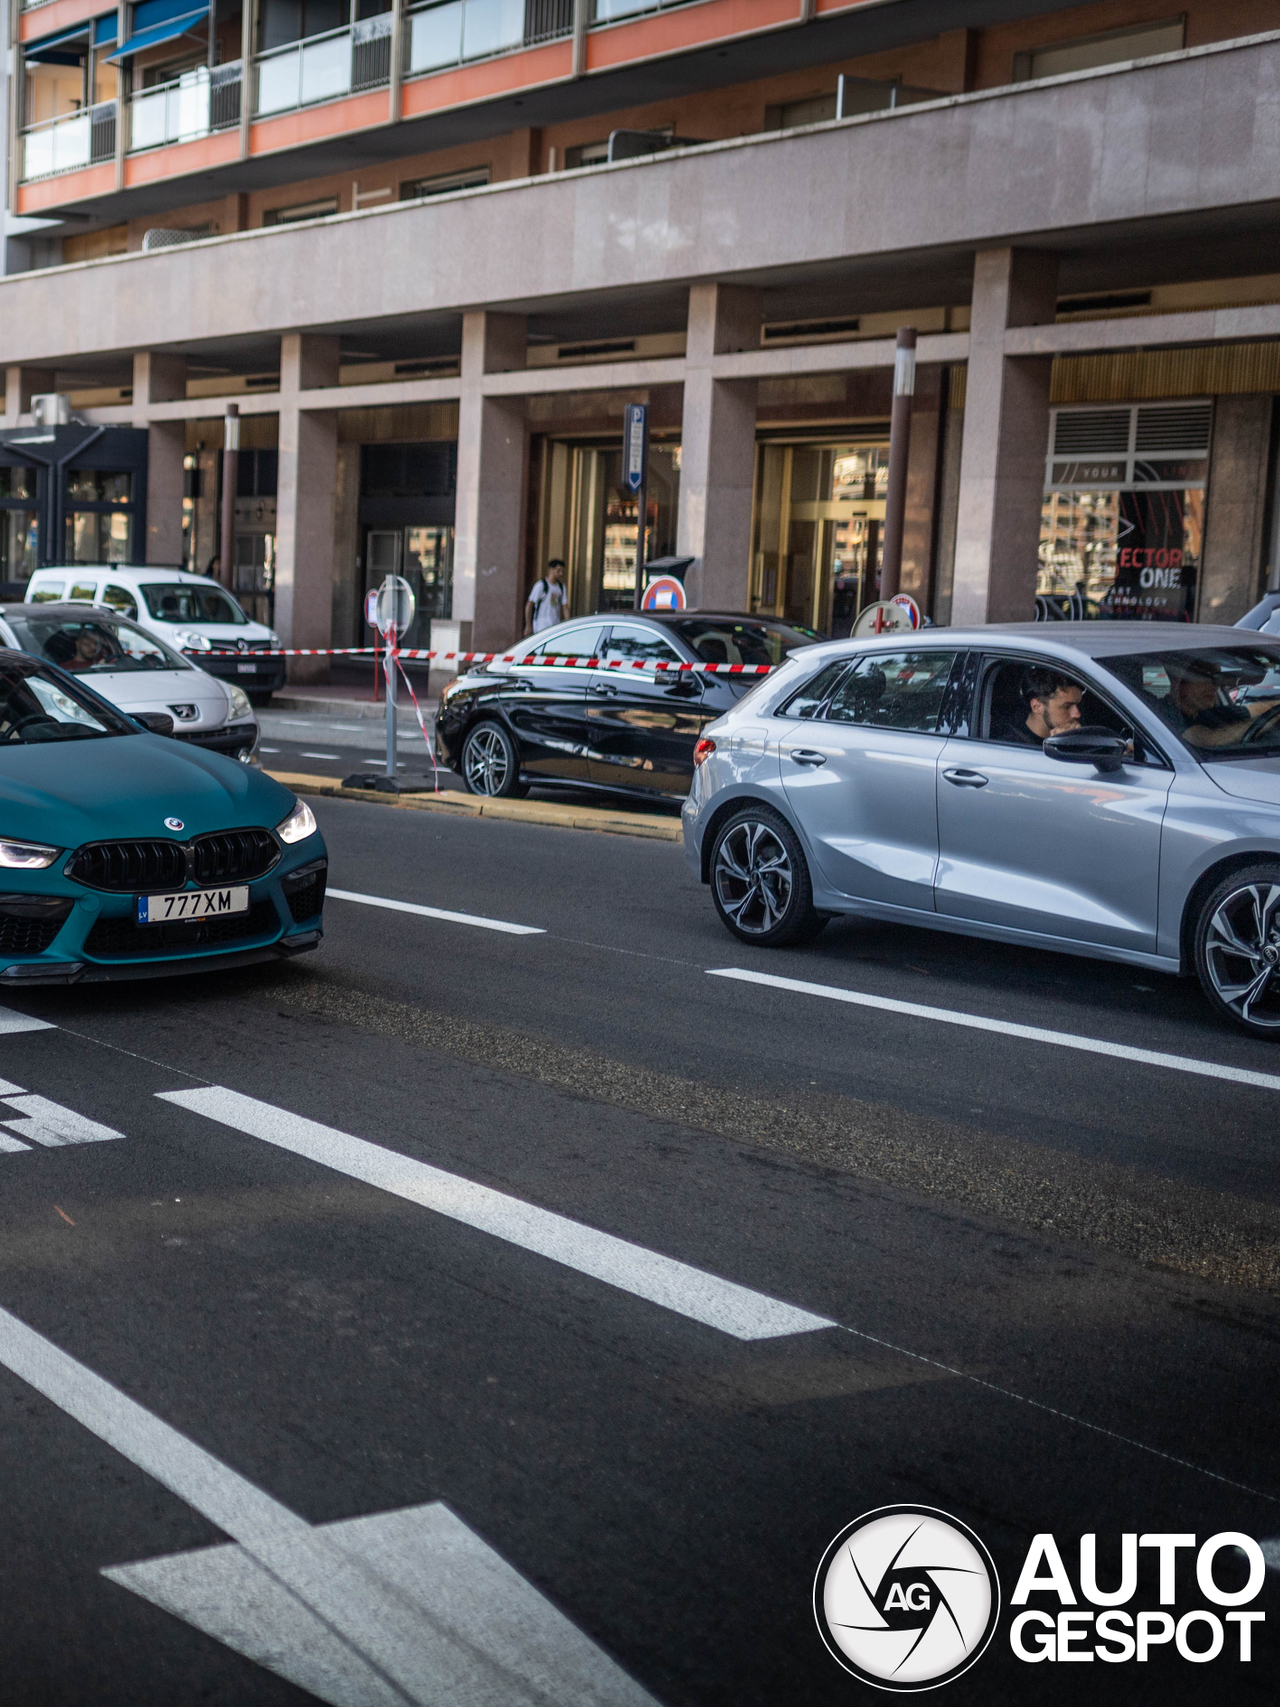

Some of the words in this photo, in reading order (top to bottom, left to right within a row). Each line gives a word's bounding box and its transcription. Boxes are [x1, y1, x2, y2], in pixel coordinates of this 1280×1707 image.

[1083, 466, 1118, 478] YOUR
[1140, 567, 1181, 588] ONE
[1101, 596, 1167, 607] ECHNOLOGY
[164, 890, 231, 918] 777XM
